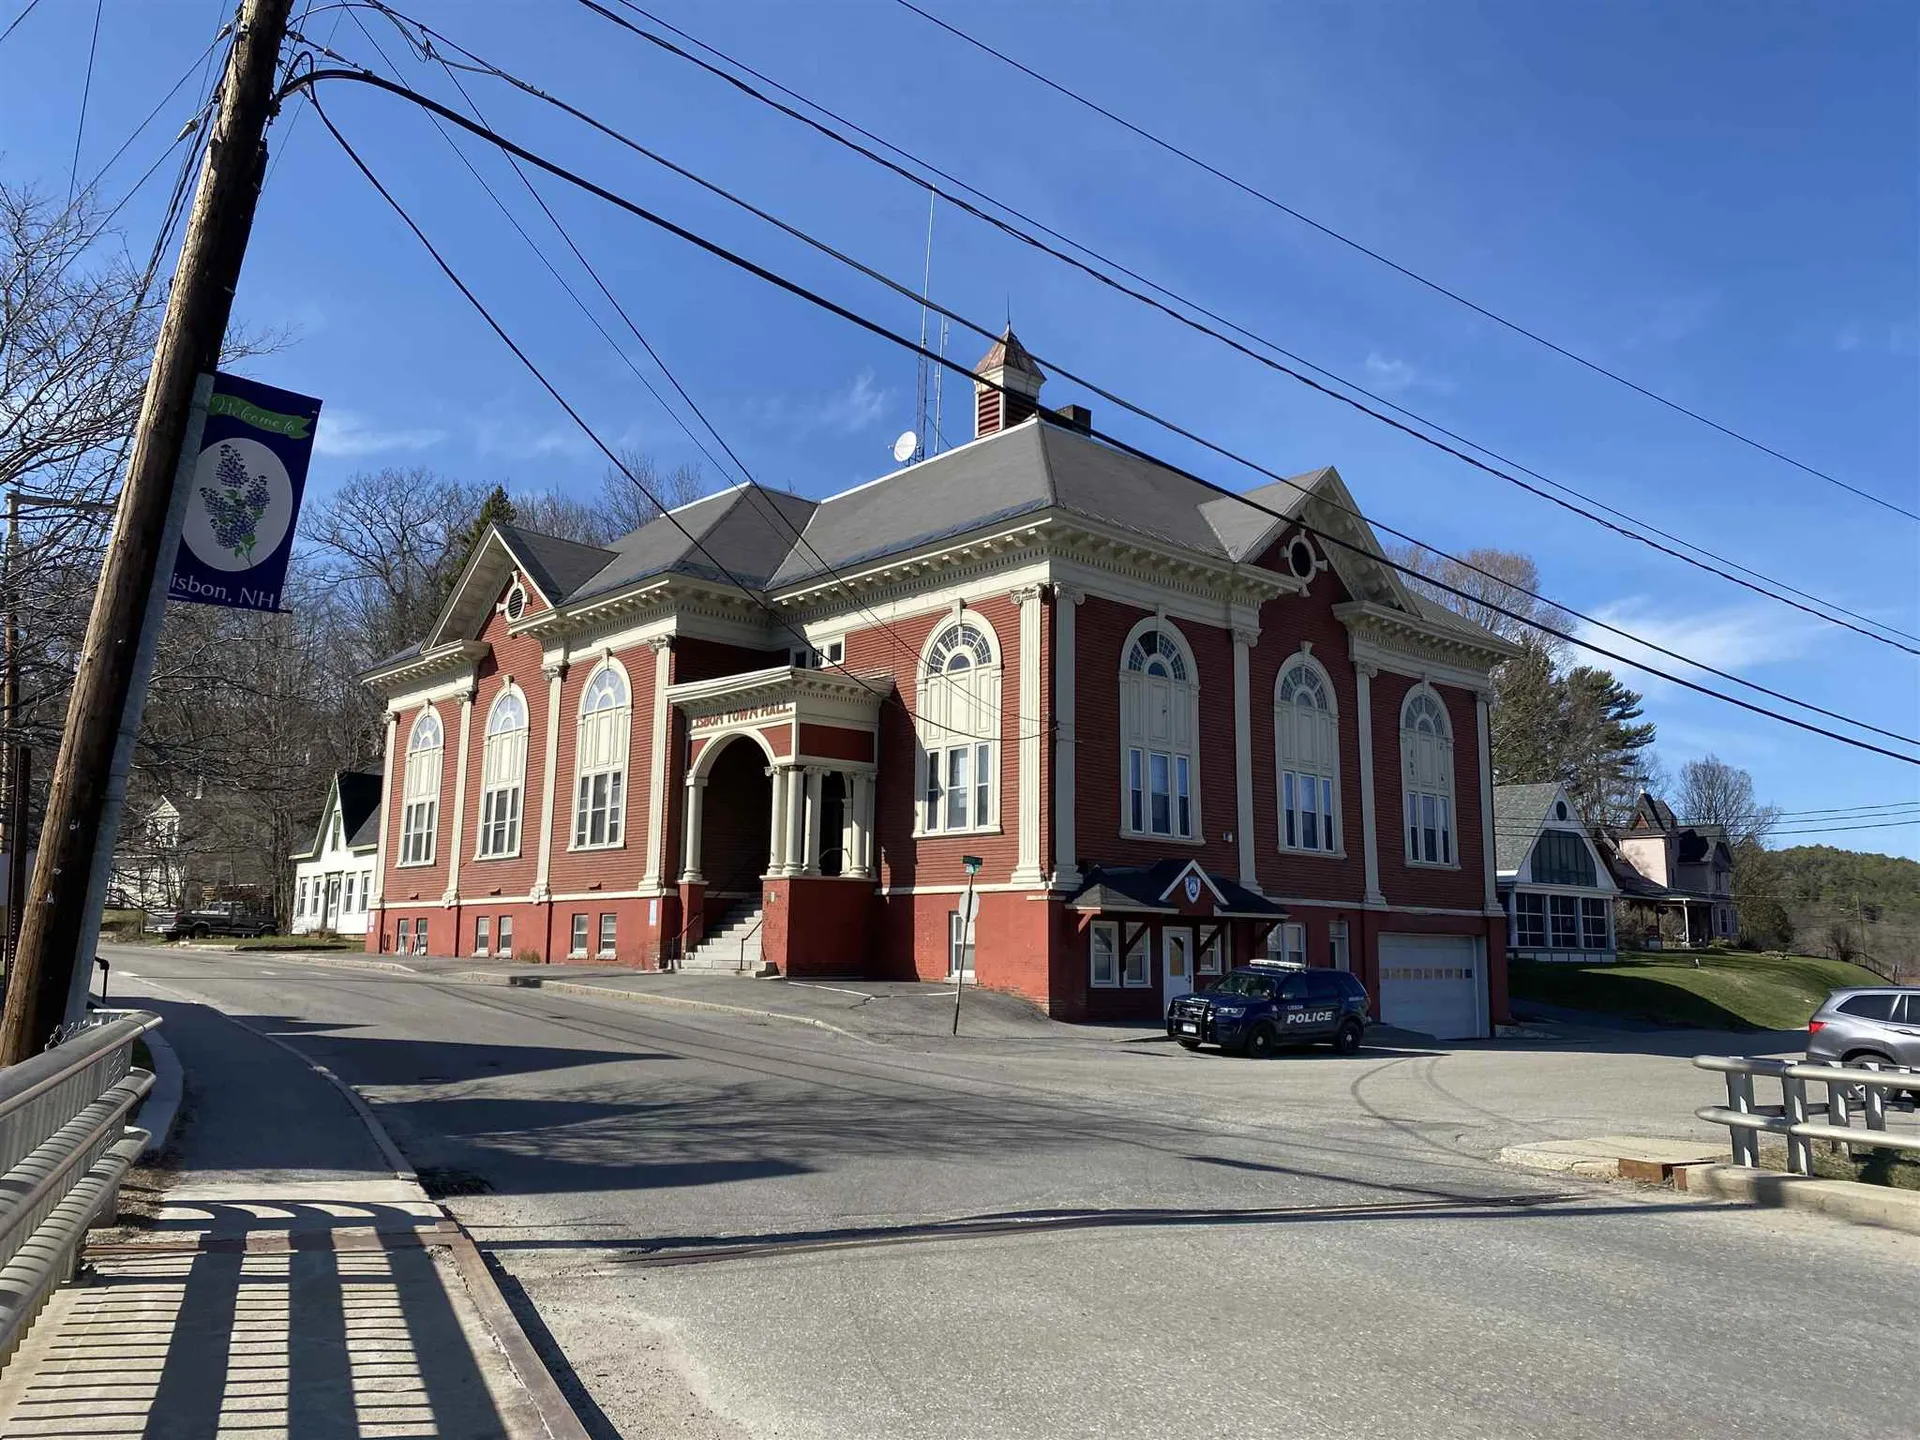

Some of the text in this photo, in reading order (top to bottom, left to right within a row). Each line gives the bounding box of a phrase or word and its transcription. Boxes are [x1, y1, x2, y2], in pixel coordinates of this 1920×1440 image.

[170, 572, 274, 609] isbon, NH
[726, 706, 759, 723] TOWN
[1286, 1011, 1333, 1024] POLICE
